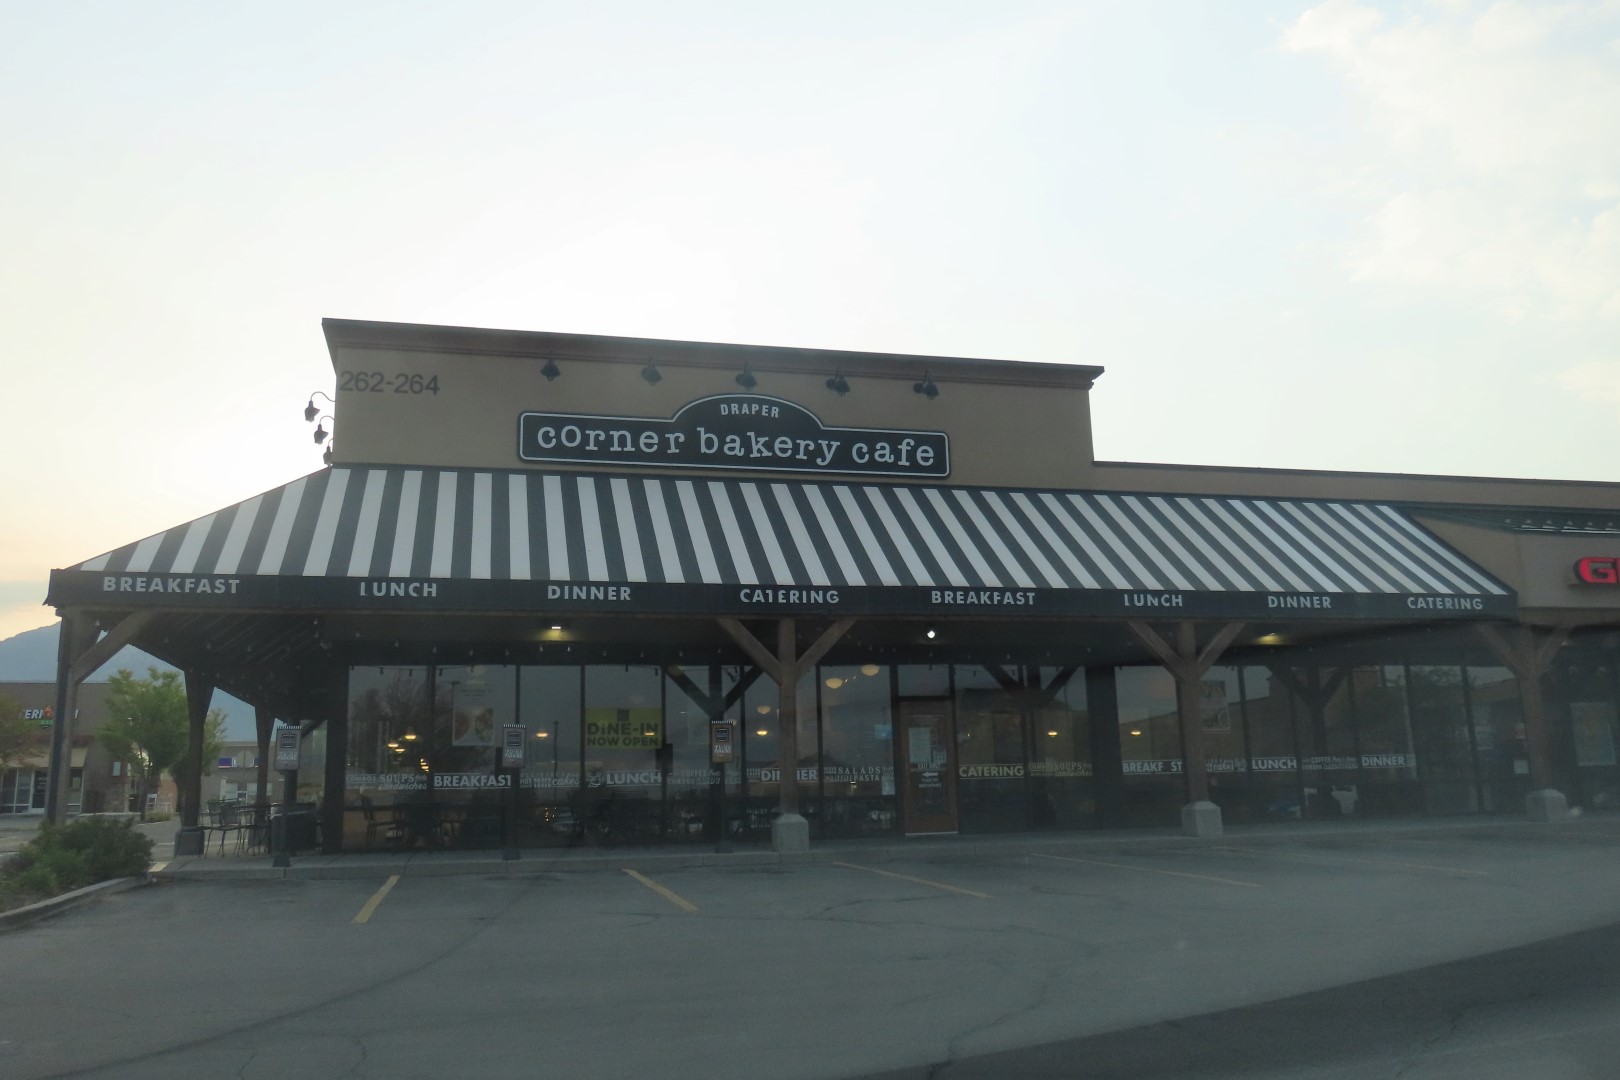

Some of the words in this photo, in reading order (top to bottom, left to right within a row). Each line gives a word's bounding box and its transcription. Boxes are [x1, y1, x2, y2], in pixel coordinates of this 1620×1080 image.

[339, 371, 440, 395] 262-264
[720, 403, 780, 418] DRAPER
[537, 425, 686, 454] corner
[696, 427, 841, 466] bakery
[851, 438, 935, 467] cafe
[1578, 557, 1620, 585] G
[103, 576, 240, 595] BREAKFAST
[359, 581, 437, 598] LUNCH
[547, 585, 632, 602] DINNER
[739, 588, 840, 604] CATERING
[931, 590, 1036, 605] BREAKFAST
[1123, 593, 1184, 607] LUNCH
[1267, 595, 1332, 609] DINNER
[1406, 596, 1484, 610] CATERING
[587, 736, 620, 746] NOW
[623, 736, 659, 746] OPEN
[1122, 761, 1183, 773] BREAKFST
[1251, 758, 1297, 770] LUNCH
[1361, 755, 1405, 766] DINNER
[379, 773, 415, 783] SOUPS
[606, 771, 662, 785] LUNCH
[761, 769, 818, 782] DIER
[837, 767, 881, 775] SALADS
[853, 774, 880, 782] PASTA
[958, 765, 1025, 778] CATERING
[378, 782, 428, 791] sandwiches
[433, 774, 512, 788] BREAKFAST
